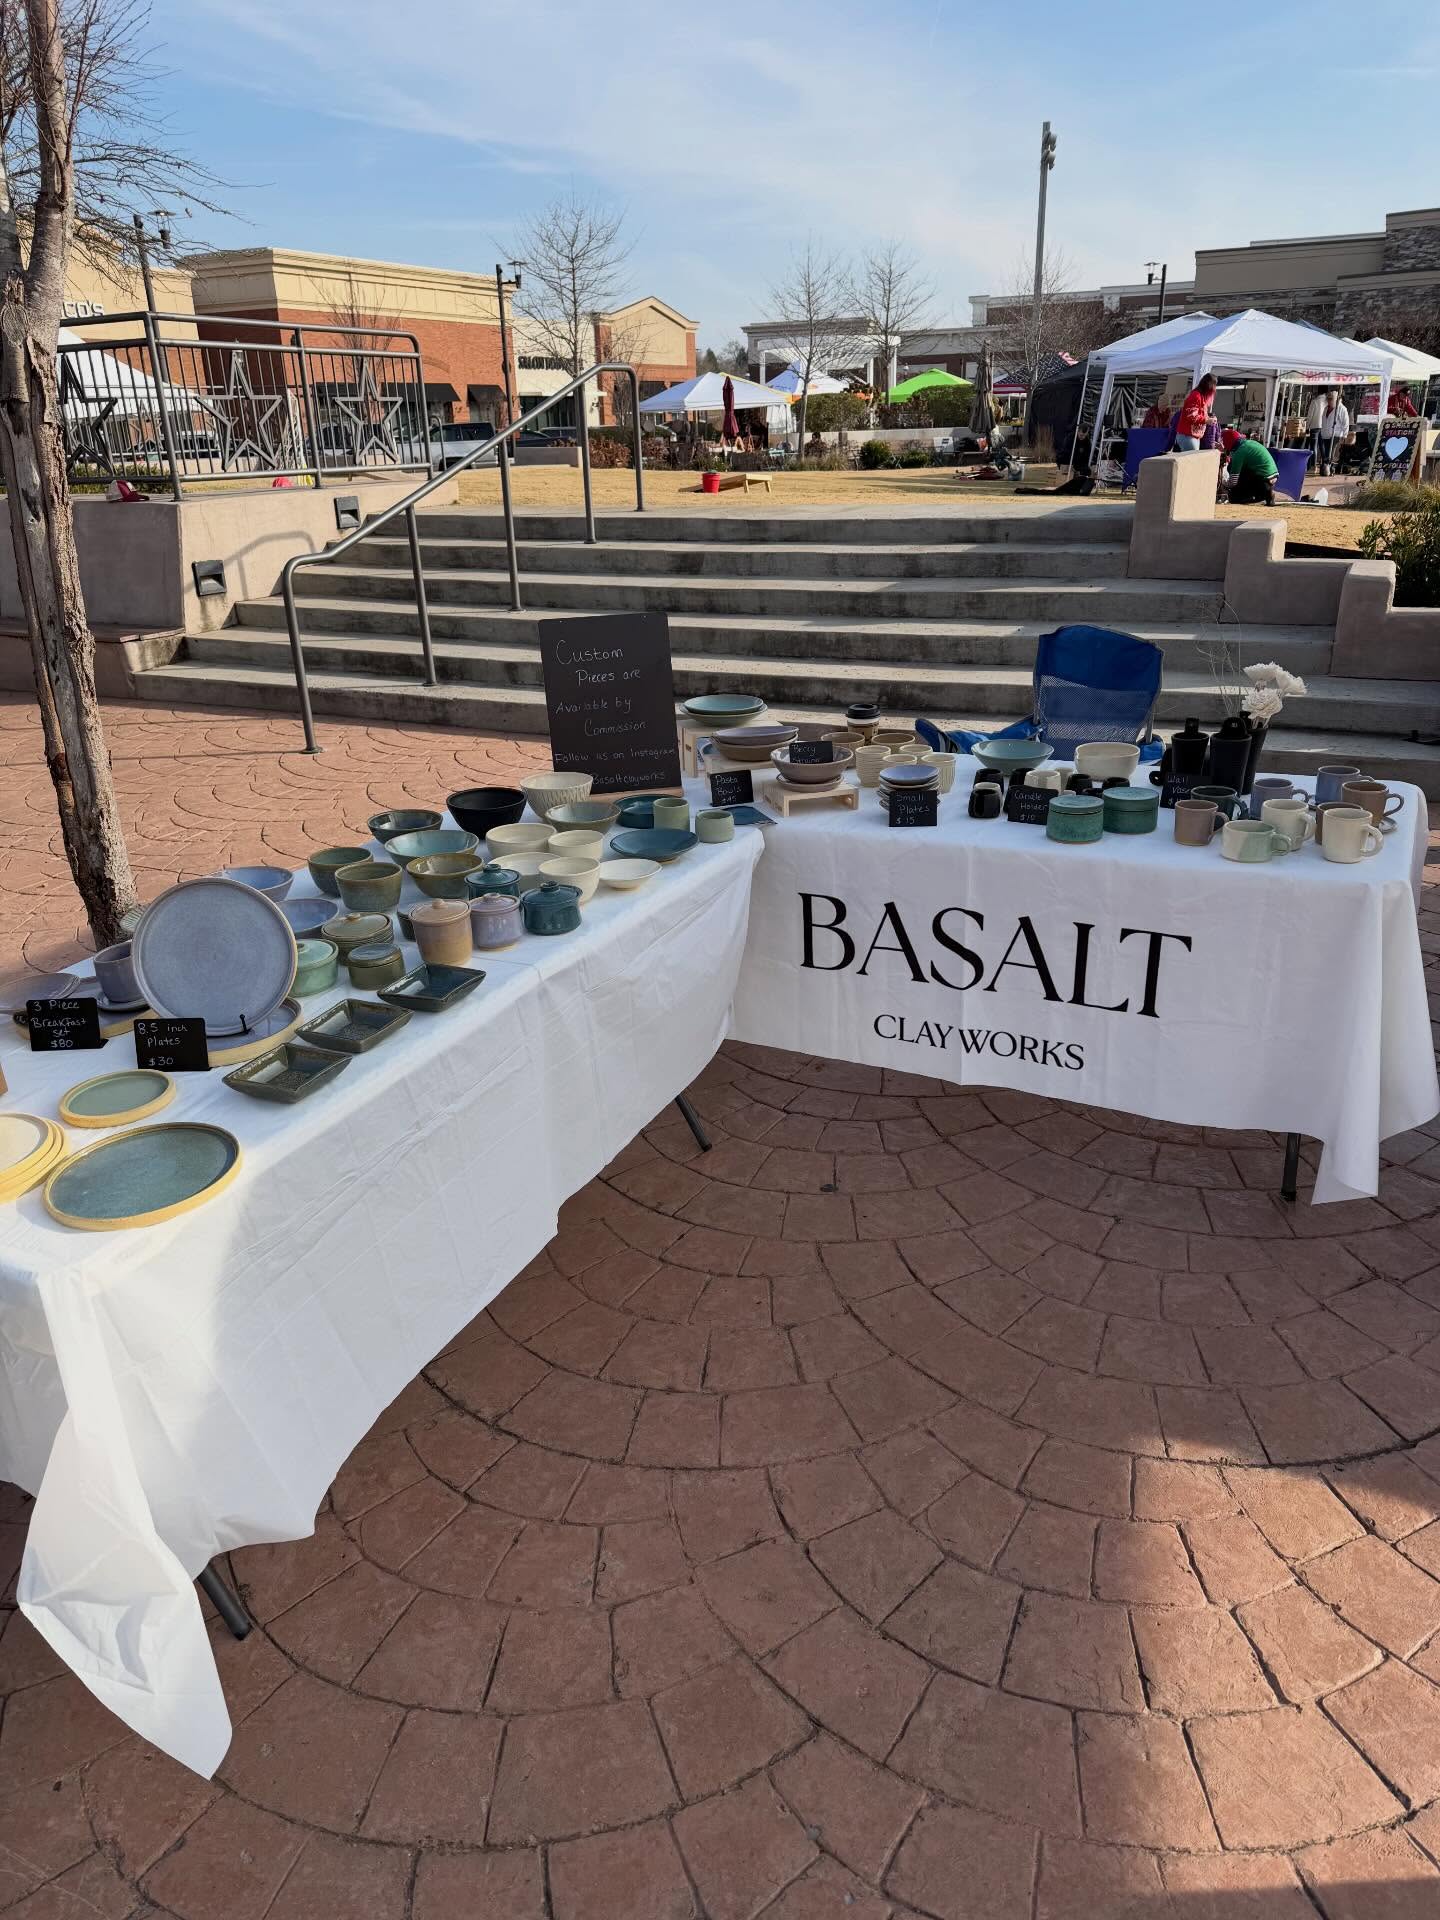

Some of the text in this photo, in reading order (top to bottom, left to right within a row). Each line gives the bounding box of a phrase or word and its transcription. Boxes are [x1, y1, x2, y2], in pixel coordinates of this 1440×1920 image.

[555, 639, 625, 665] Custom
[575, 669, 641, 686] Pieces are
[555, 697, 632, 715] Available by
[584, 719, 648, 737] Commission
[555, 752, 589, 764] Follow
[612, 751, 625, 760] on
[630, 747, 676, 760] Instagram
[1014, 790, 1042, 801] Candle
[798, 892, 1192, 1018] BASALT
[33, 999, 80, 1011] 3 Piece
[137, 1022, 188, 1035] 8.5 inch
[50, 1038, 74, 1048] $80
